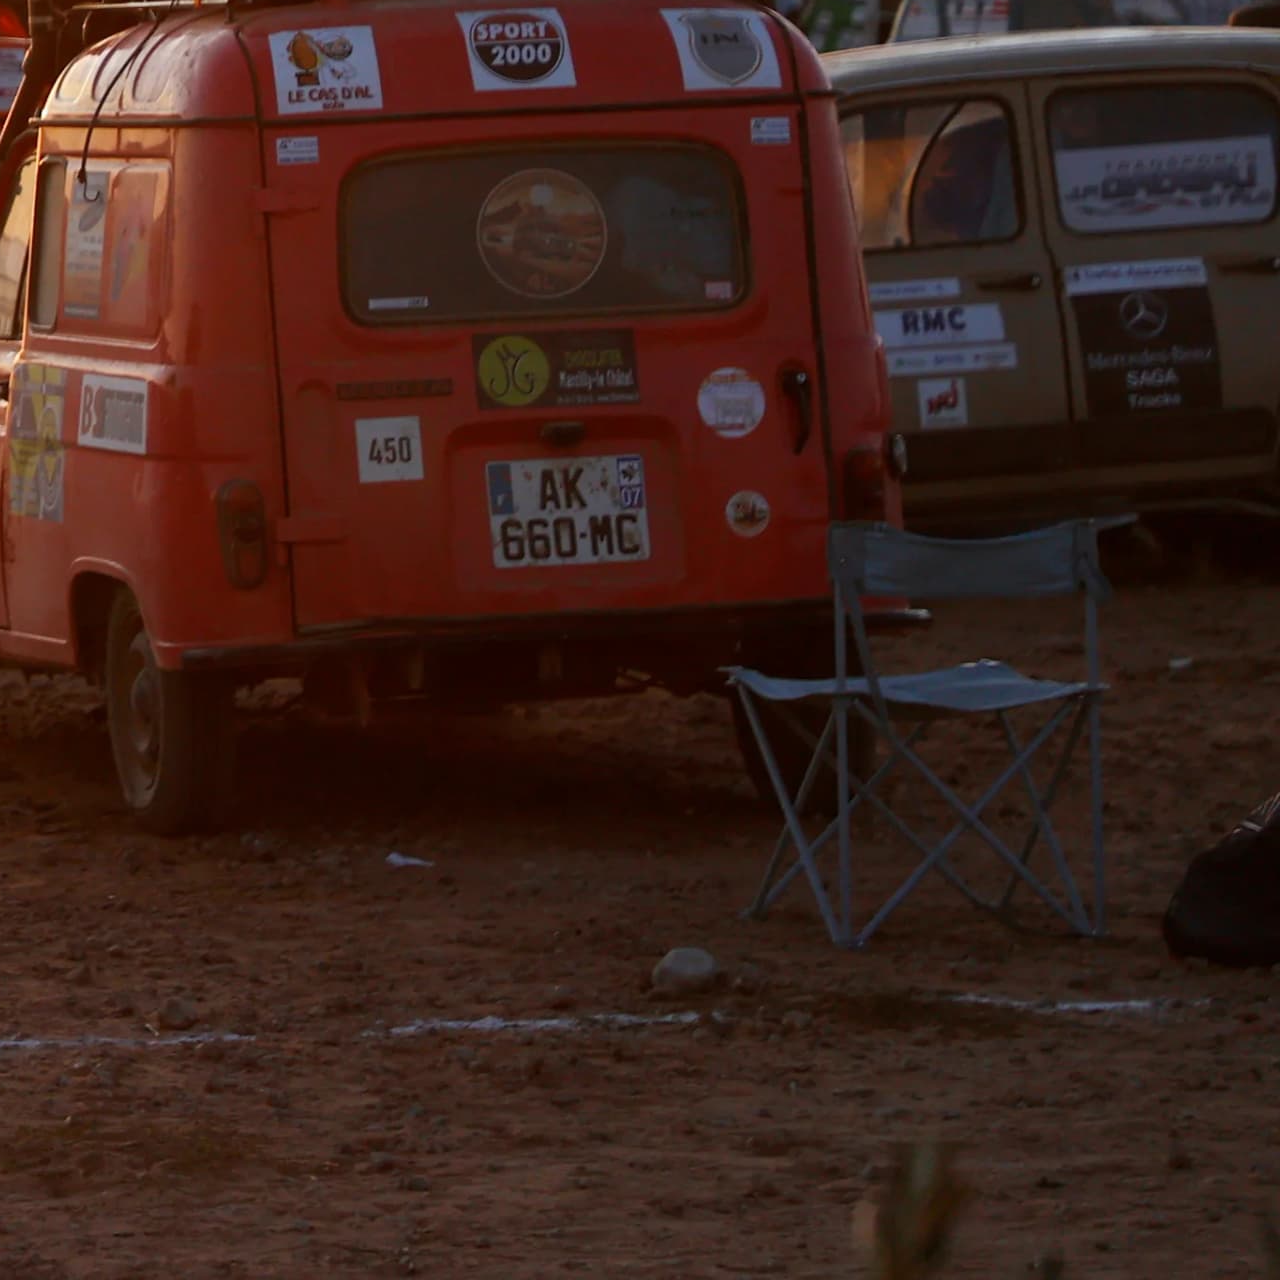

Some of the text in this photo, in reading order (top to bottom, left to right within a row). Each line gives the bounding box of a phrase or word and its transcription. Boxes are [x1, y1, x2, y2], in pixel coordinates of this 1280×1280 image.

[476, 21, 548, 40] SPORT
[491, 43, 551, 65] 2000
[288, 89, 305, 104] LE
[308, 87, 338, 102] CAS
[902, 306, 967, 336] RMC
[368, 435, 412, 465] 450
[540, 467, 587, 510] AK
[621, 487, 641, 506] 07
